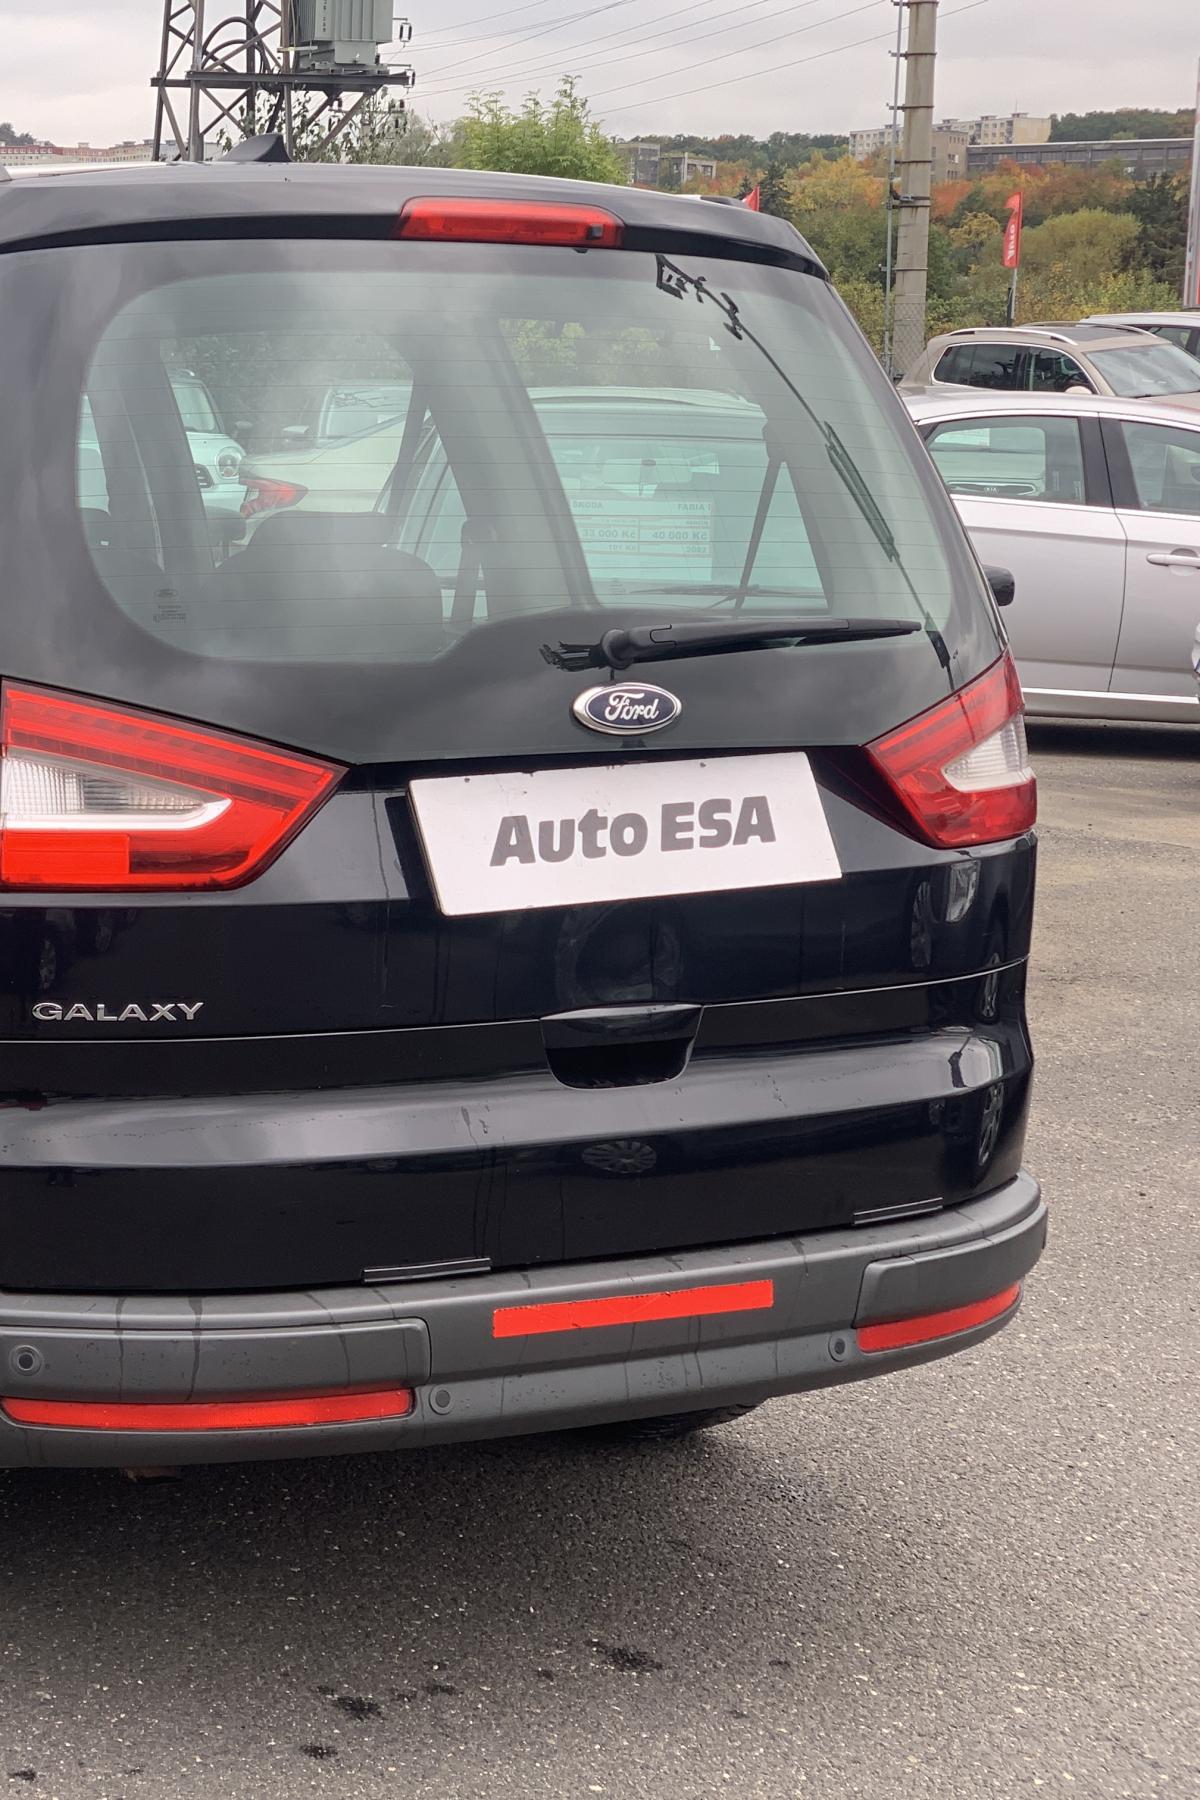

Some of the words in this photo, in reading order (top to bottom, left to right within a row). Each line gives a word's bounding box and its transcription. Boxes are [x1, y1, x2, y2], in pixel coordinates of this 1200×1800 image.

[604, 691, 660, 721] Ford
[489, 808, 649, 867] Auto
[660, 795, 776, 852] ESA
[32, 1002, 204, 1021] GALAXY
